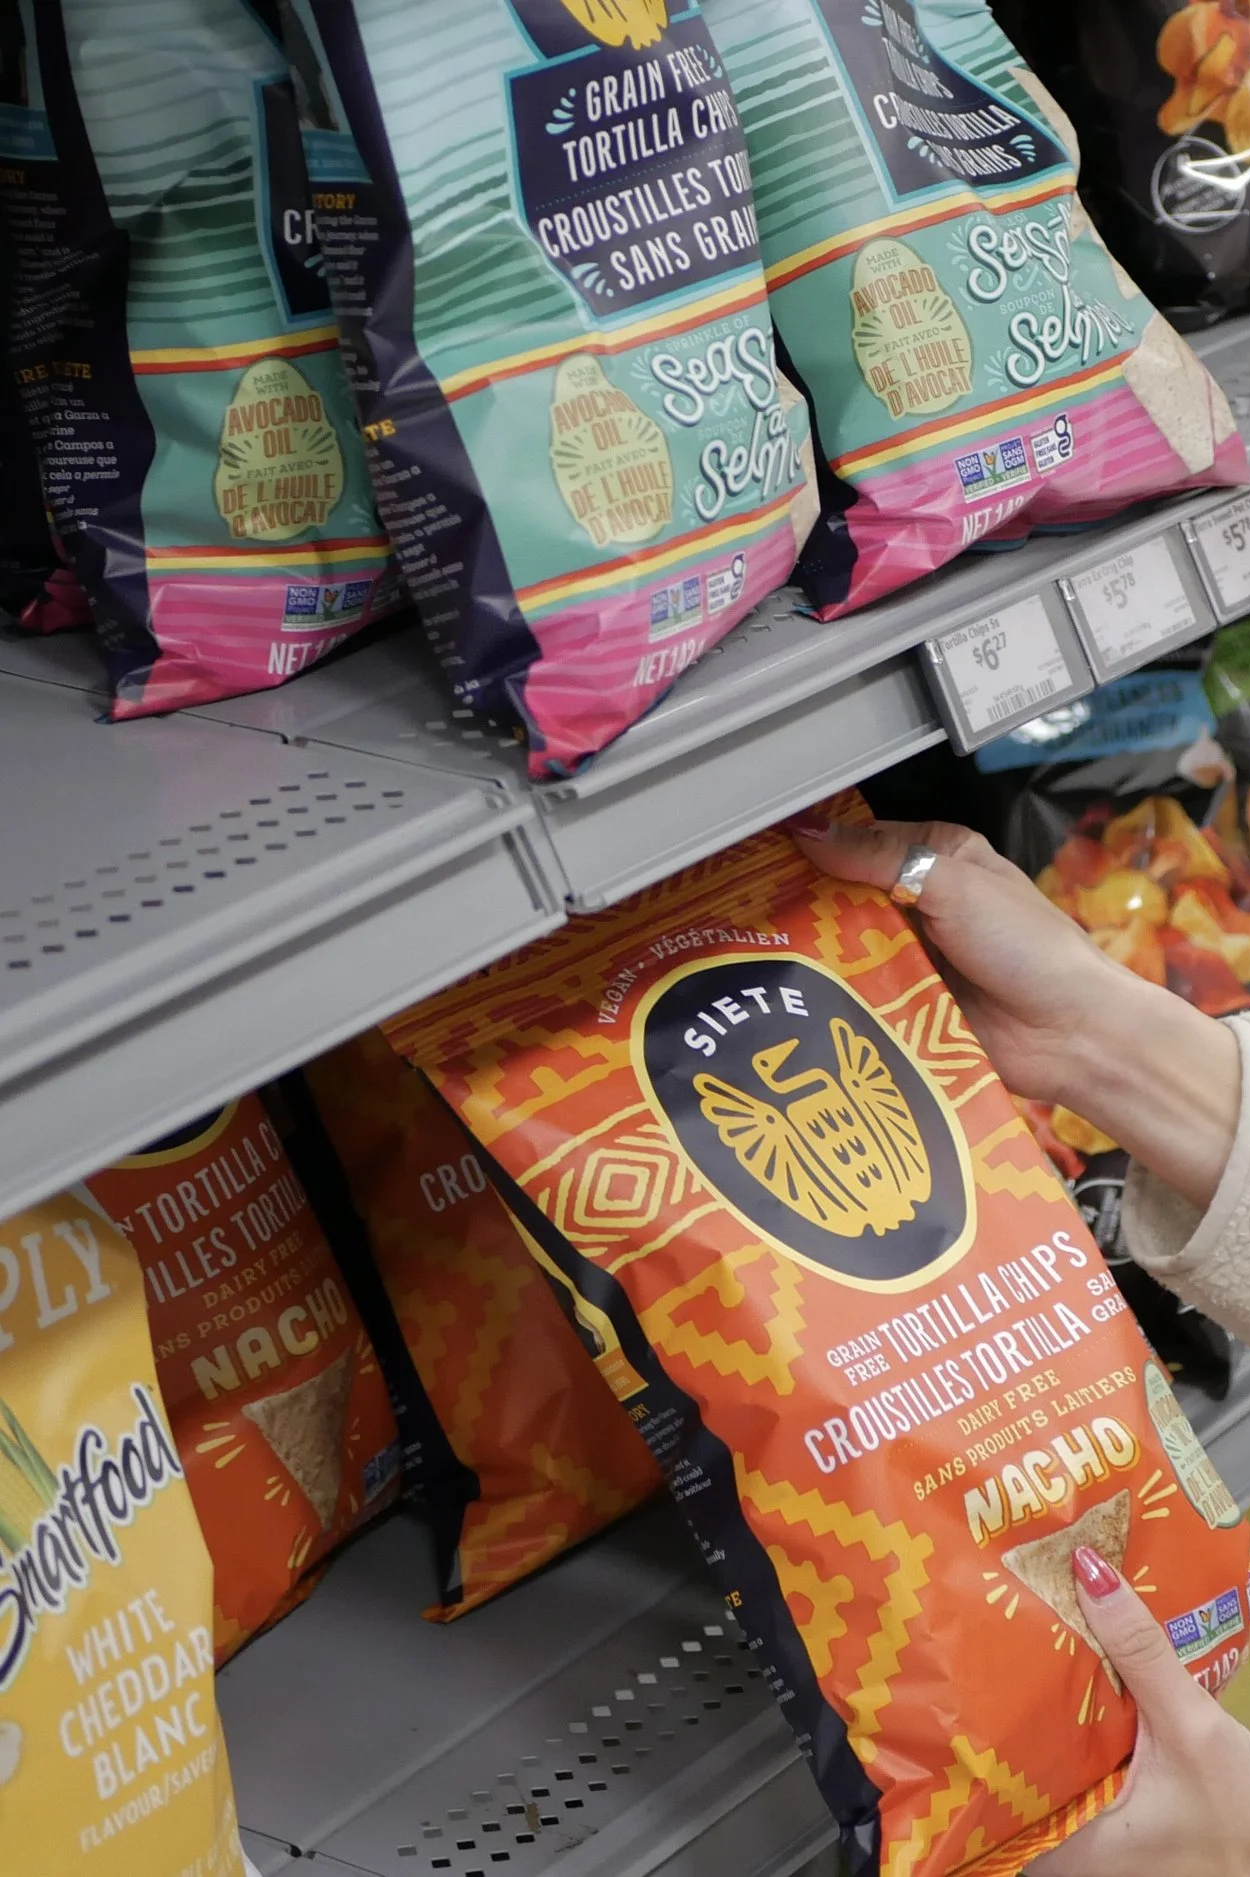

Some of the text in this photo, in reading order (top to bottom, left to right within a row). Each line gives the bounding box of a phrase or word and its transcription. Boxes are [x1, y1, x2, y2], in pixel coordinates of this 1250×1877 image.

[585, 46, 711, 122] GRAIN FREE
[563, 89, 739, 182] TORTILLA CHIPS
[538, 167, 712, 258] CROUSTILLES
[610, 231, 691, 290] SANS
[866, 248, 900, 265] MADE
[870, 260, 901, 274] WITH
[853, 267, 936, 318] AVOCADO
[1000, 288, 1055, 315] SOUPÇON
[1039, 303, 1054, 316] DE
[889, 301, 922, 329] OIL
[884, 327, 940, 352] FAIT AVEC
[253, 370, 288, 386] MADE
[870, 338, 969, 393] DE L'HUILE
[256, 382, 289, 396] WITH
[887, 366, 970, 417] D'AVOCAT
[228, 394, 322, 437] AVOCADO
[591, 416, 628, 451] OIL
[263, 427, 297, 458] OIL
[1002, 446, 1022, 460] SANS
[247, 465, 276, 479] FAIT
[585, 459, 613, 476] FAIT
[957, 455, 978, 467] NON
[960, 465, 981, 476] GMO
[1004, 457, 1025, 468] OGM
[222, 483, 249, 514] DE
[570, 481, 601, 520] DE
[288, 597, 316, 607] GMO
[289, 588, 317, 597] NON
[968, 624, 989, 639] Chips
[632, 649, 670, 687] NET
[598, 928, 790, 1024] VEGAN VÉGÉTALIEN
[684, 986, 809, 1057] SIETE
[135, 1137, 266, 1243] TORTILLA
[203, 1258, 268, 1309] DAIRY
[826, 1231, 1087, 1368] GRAIN TORTILLA CHIPS
[197, 1268, 301, 1339] PRODUITS
[191, 1277, 350, 1400] NACHO
[804, 1358, 975, 1475] CROUSTILLES
[960, 1302, 1092, 1391] TORTILLA
[845, 1354, 890, 1387] FREE
[958, 1368, 1062, 1437] DAIRY FREE
[913, 1457, 967, 1501] SANS
[965, 1409, 1049, 1467] PRODUITS
[1051, 1366, 1137, 1417] LAITIERS
[963, 1416, 1140, 1549] NACHO
[1168, 1615, 1194, 1632] NON
[1171, 1624, 1197, 1640] GMO
[1220, 1607, 1238, 1622] OGM
[66, 1589, 174, 1684] WHITE
[60, 1625, 214, 1758] CHEDDAR
[93, 1692, 207, 1801] BLANC
